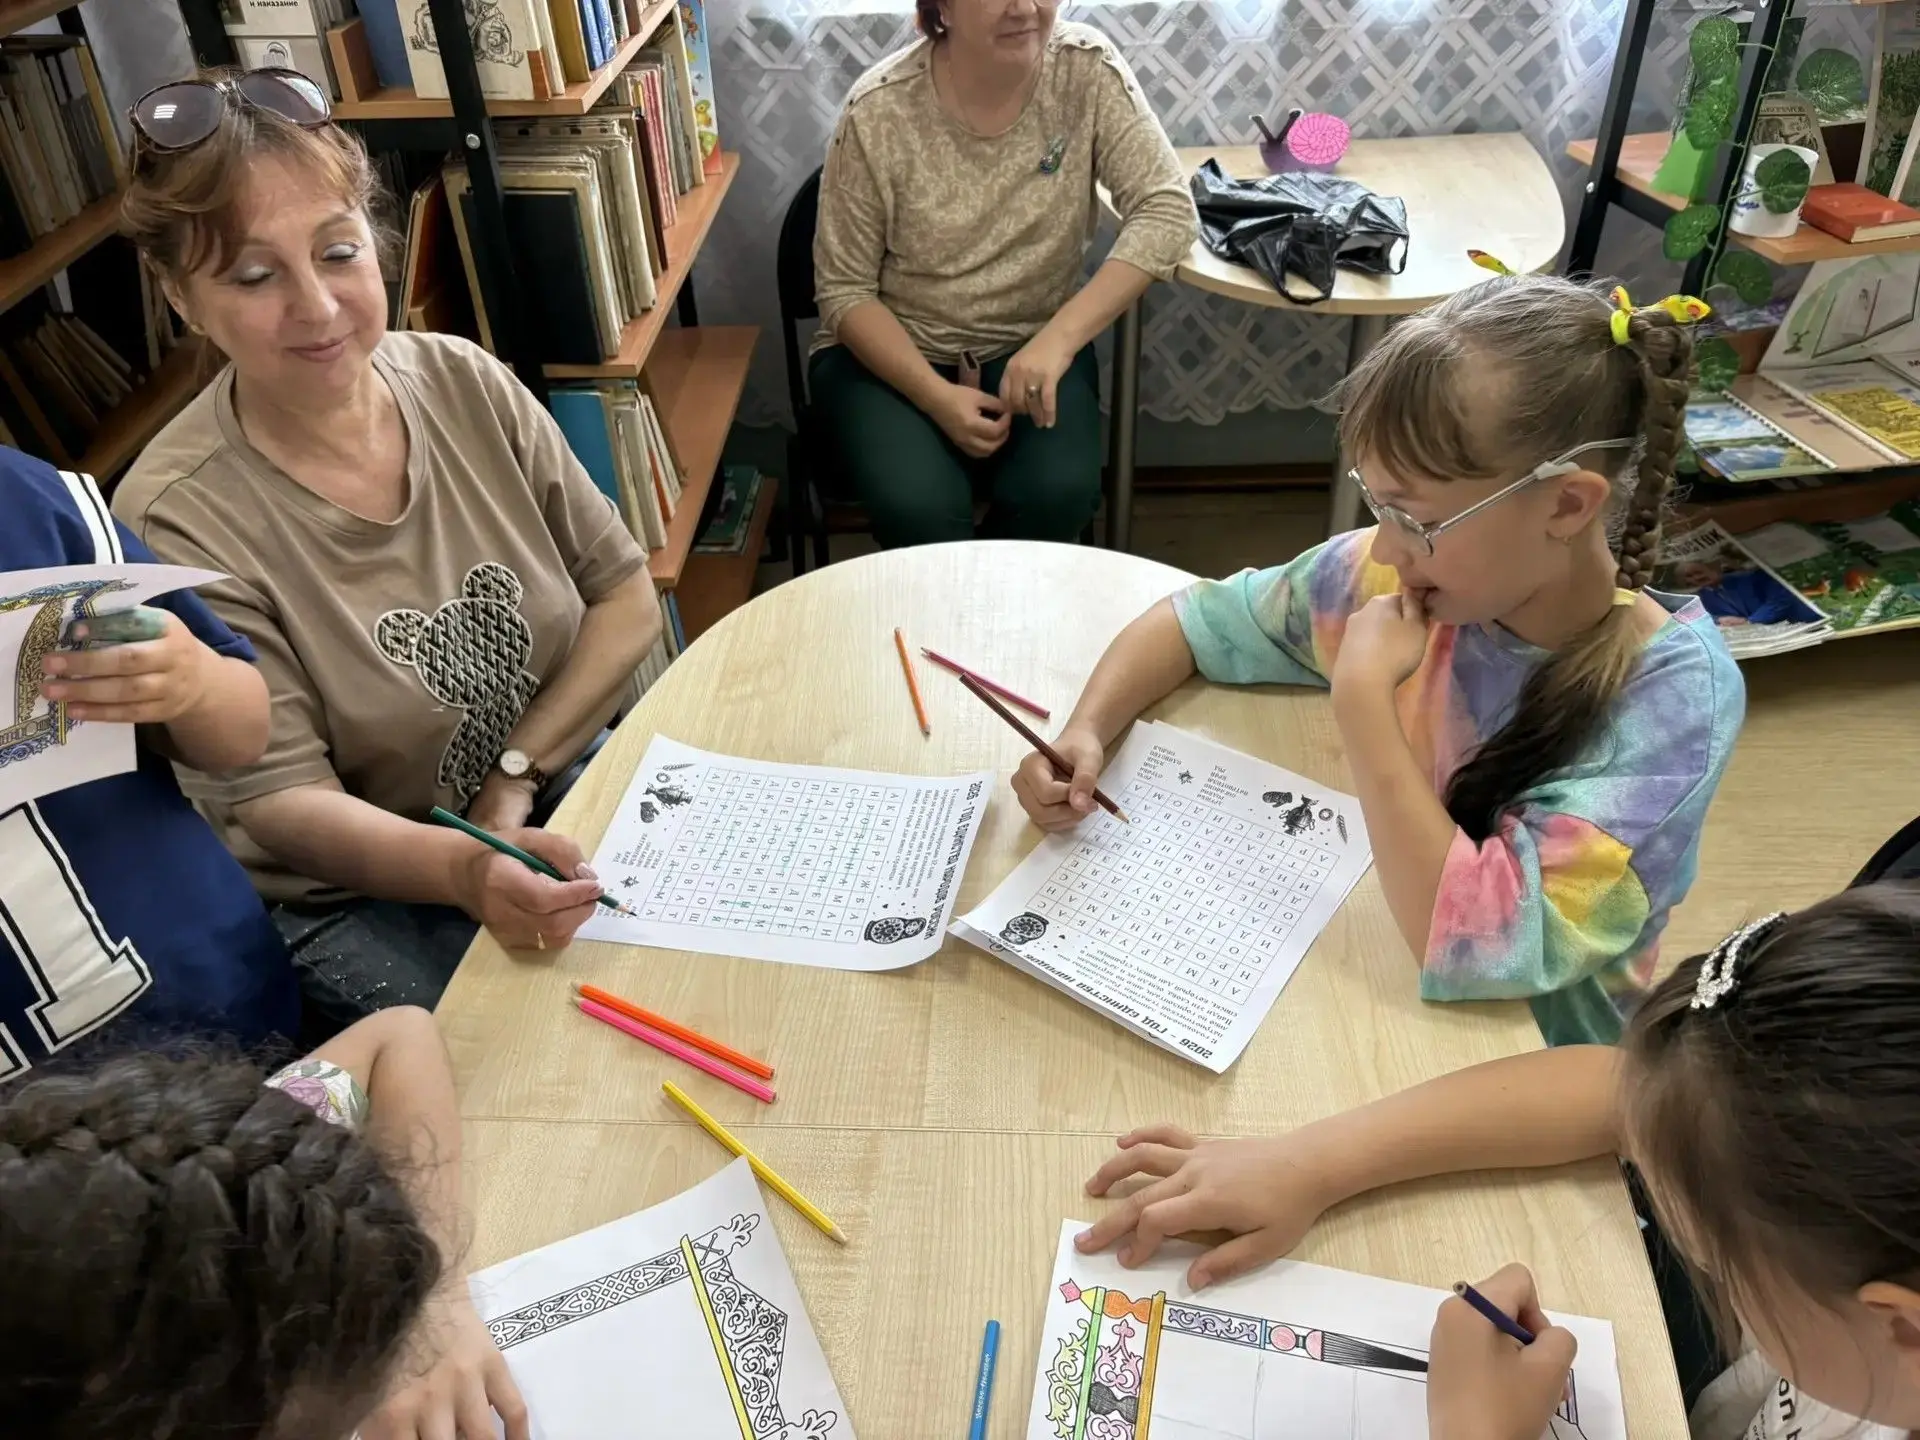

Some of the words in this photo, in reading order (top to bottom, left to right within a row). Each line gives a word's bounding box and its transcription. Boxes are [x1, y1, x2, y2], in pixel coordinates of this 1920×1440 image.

[957, 806, 974, 824] ГОД
[1079, 846, 1092, 855] М
[1070, 859, 1079, 867] Е
[1101, 855, 1111, 863] З
[1090, 868, 1100, 876] Я
[1121, 863, 1131, 872] И
[1110, 875, 1121, 884] Д
[1141, 872, 1149, 880] Т
[1077, 881, 1087, 889] К
[1162, 880, 1172, 888] О
[1046, 886, 1056, 894] Н
[1100, 890, 1108, 898] Е
[1183, 888, 1194, 898] И
[1150, 893, 1161, 902] М
[1037, 900, 1046, 908] С
[1086, 903, 1097, 912] М
[1119, 899, 1130, 908] И
[1140, 908, 1150, 916] С
[1196, 911, 1207, 920] Д
[1226, 908, 1235, 916] Т
[1111, 913, 1119, 921] А
[1164, 917, 1173, 925] А
[1251, 916, 1260, 924] А
[1129, 922, 1140, 931] Н
[1217, 920, 1226, 928] А
[1096, 927, 1109, 937] Ж
[1184, 926, 1195, 935] Л
[1239, 929, 1251, 939] Д
[1271, 925, 1282, 934] П
[1151, 931, 1162, 941] И
[1118, 938, 1127, 946] У
[1173, 940, 1185, 950] Д
[1260, 939, 1271, 948] И
[1228, 946, 1239, 954] О
[1162, 955, 1174, 965] Д
[1195, 951, 1206, 960] О
[1251, 955, 1261, 963] С
[1023, 953, 1075, 983] НАРОДОВ
[1218, 962, 1228, 970] Р
[1185, 967, 1197, 977] М
[1239, 970, 1250, 980] Н
[1209, 978, 1219, 986] К
[1231, 986, 1240, 995] А
[1075, 980, 1140, 1019] ЕДИНСТВА
[1140, 1014, 1168, 1034] ГОД
[1177, 1036, 1213, 1059] 2026
